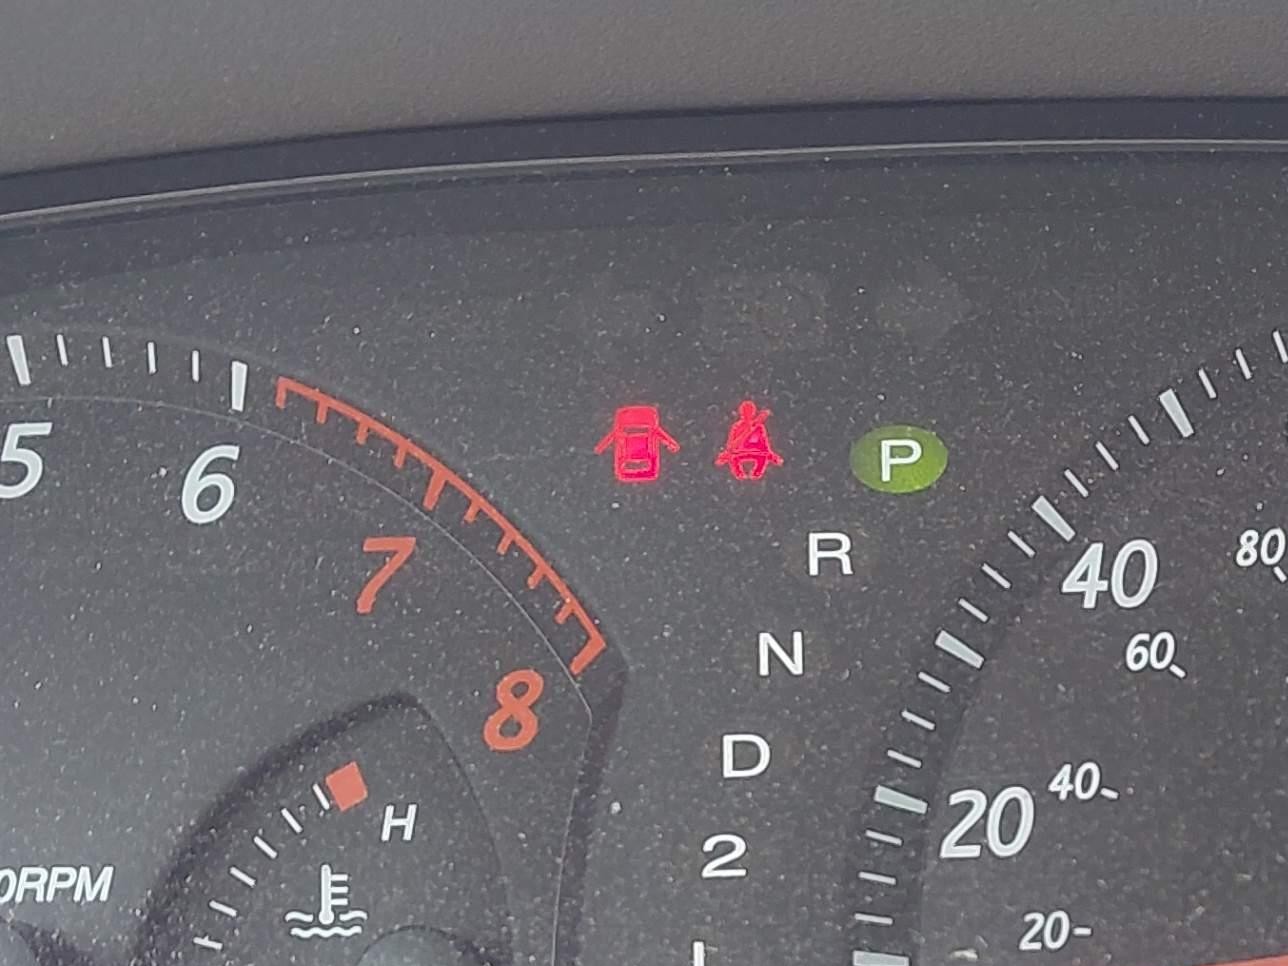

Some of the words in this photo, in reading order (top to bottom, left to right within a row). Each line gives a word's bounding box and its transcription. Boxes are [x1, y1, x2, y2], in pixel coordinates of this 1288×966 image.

[0, 422, 53, 499] 5
[880, 439, 922, 482] P
[181, 445, 240, 524] 6
[808, 532, 854, 576] R
[1236, 528, 1285, 567] 80
[355, 537, 416, 614] 7
[1061, 539, 1158, 609] 40
[759, 631, 803, 675] N
[1126, 632, 1174, 671] 60
[483, 669, 544, 750] 8
[722, 734, 771, 778] D
[1049, 762, 1100, 800] 40
[381, 804, 417, 841] H
[940, 786, 1036, 858] 20
[702, 834, 748, 878] 2
[1019, 911, 1070, 950] 20
